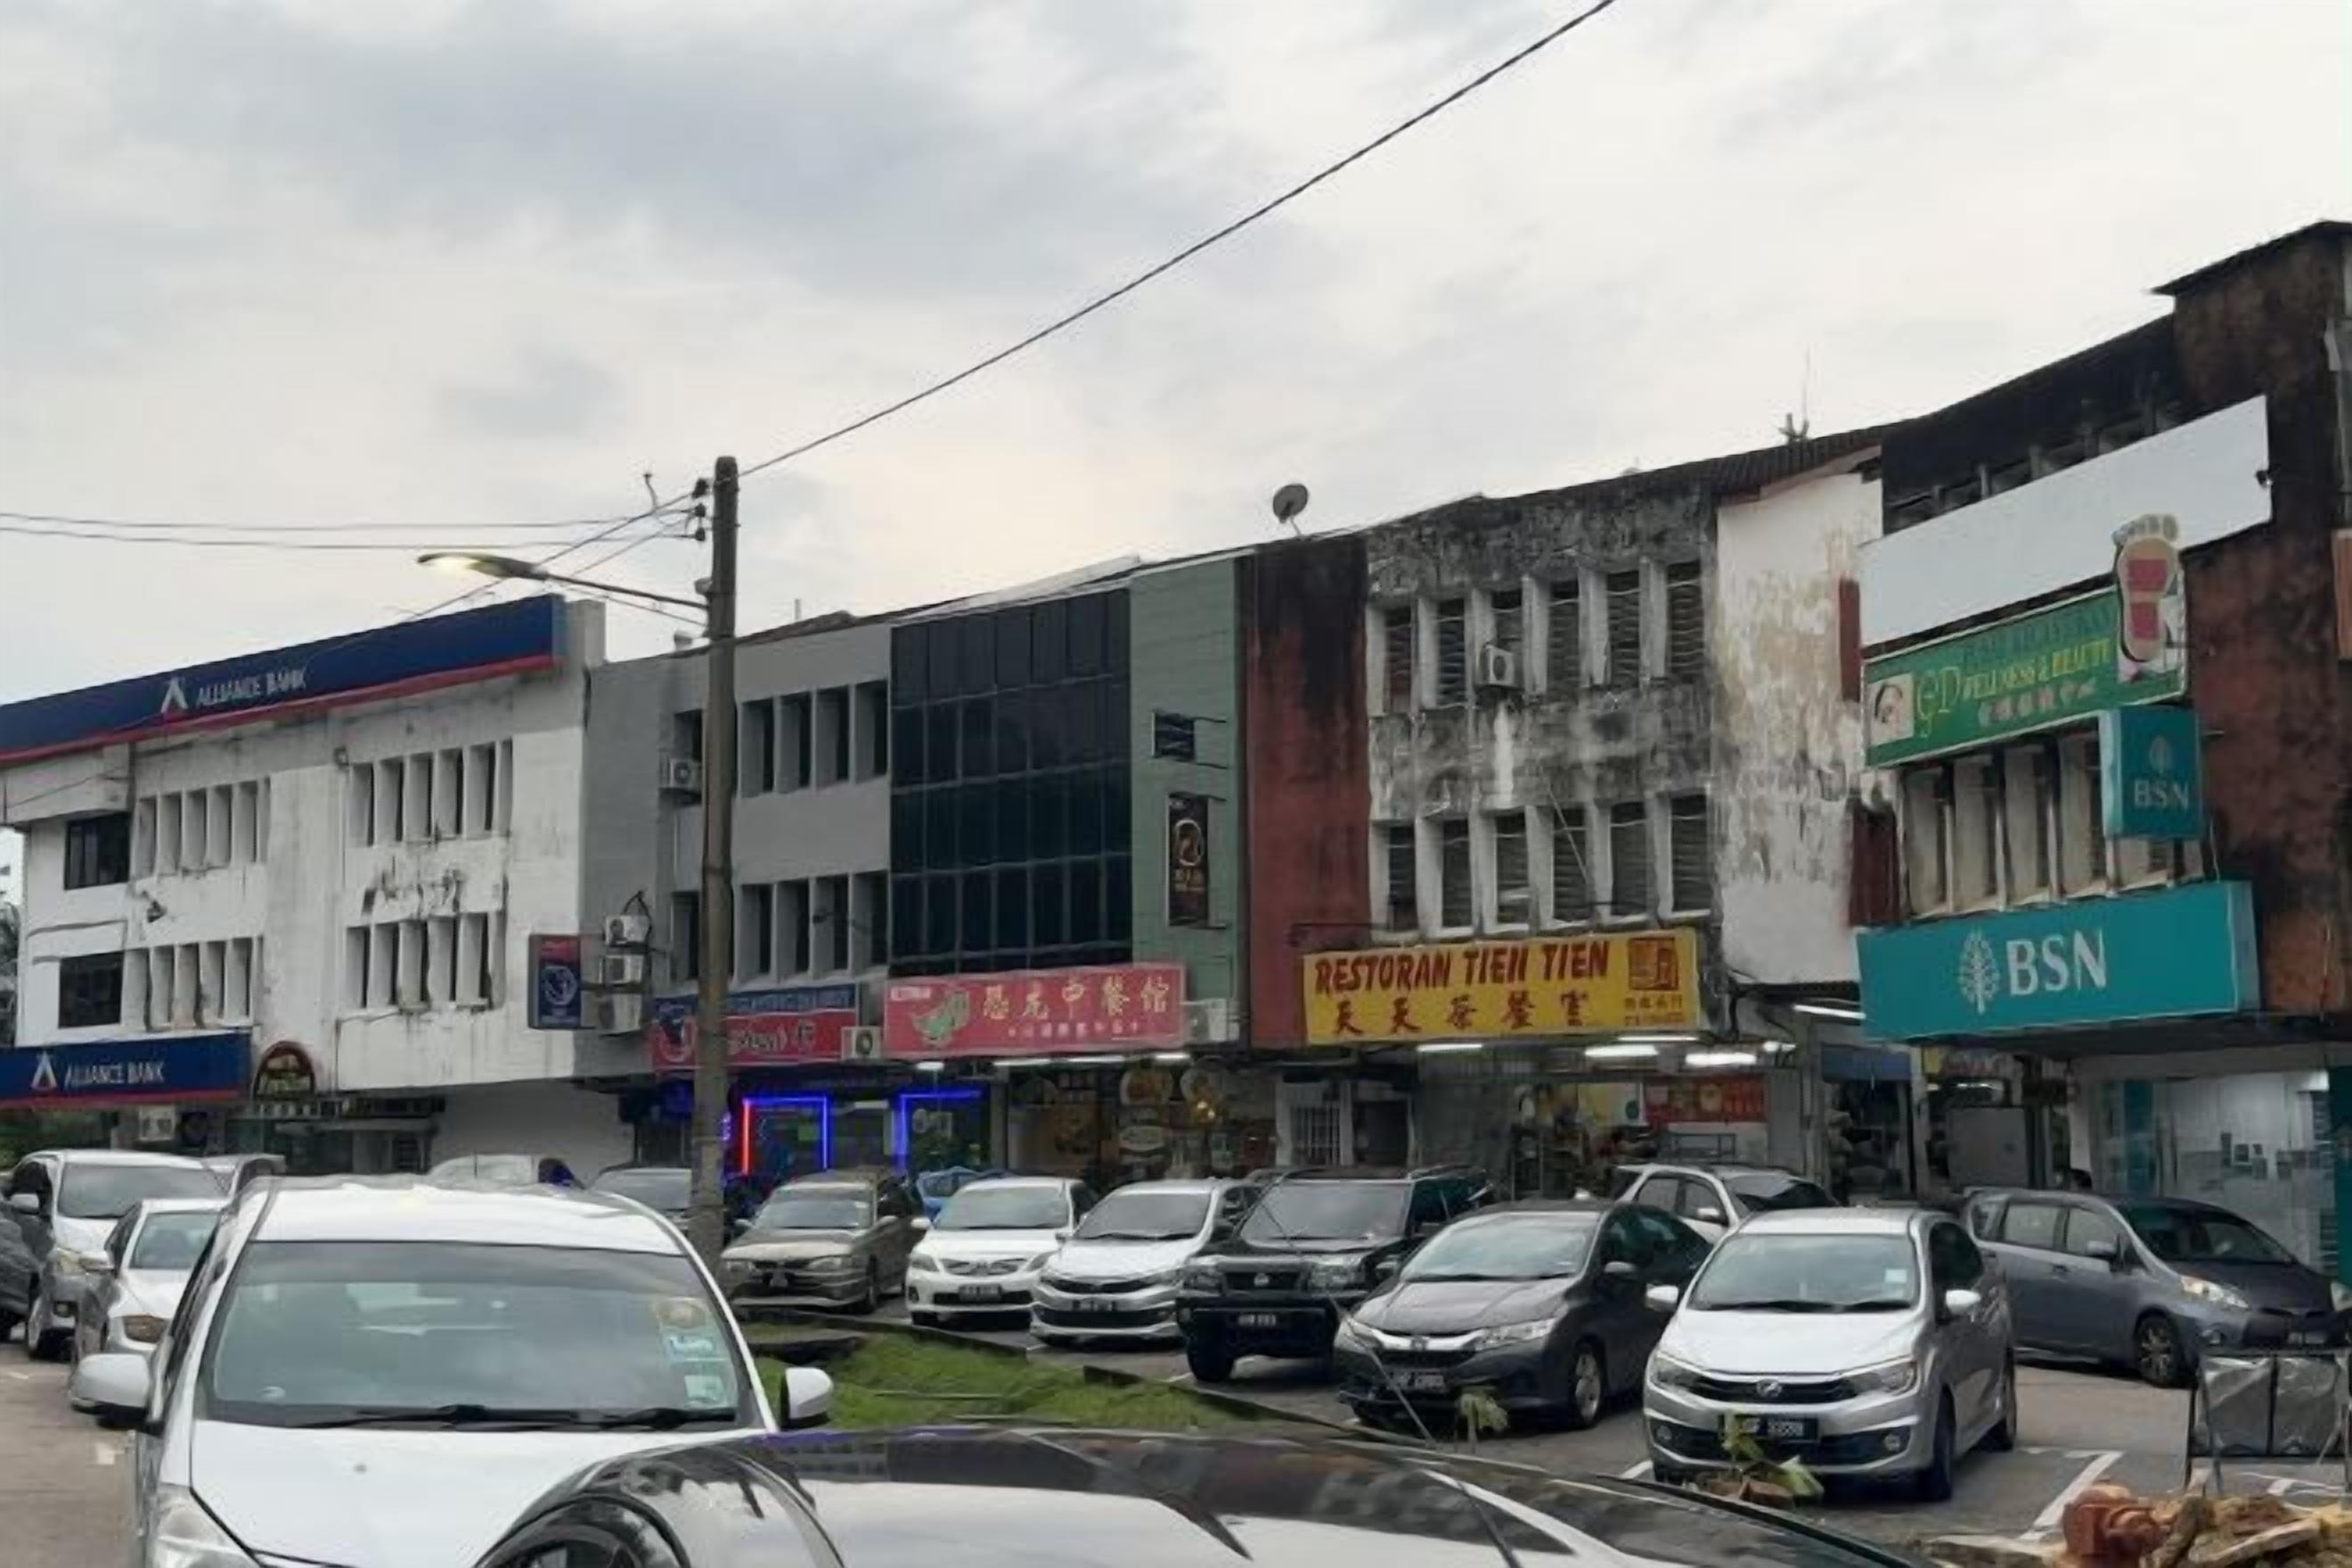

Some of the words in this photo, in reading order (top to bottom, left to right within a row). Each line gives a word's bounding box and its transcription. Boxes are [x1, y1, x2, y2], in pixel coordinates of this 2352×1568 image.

[196, 675, 261, 708] ALLIANCE
[266, 667, 307, 695] BANK
[2135, 779, 2189, 813] BSN
[1315, 952, 1451, 995] RESTORAN
[1464, 944, 1531, 986] TIEN
[1542, 940, 1610, 981] TIEN
[2006, 928, 2107, 996] BSN
[64, 1063, 124, 1090] ALLIANCE
[127, 1061, 166, 1084] BANK
